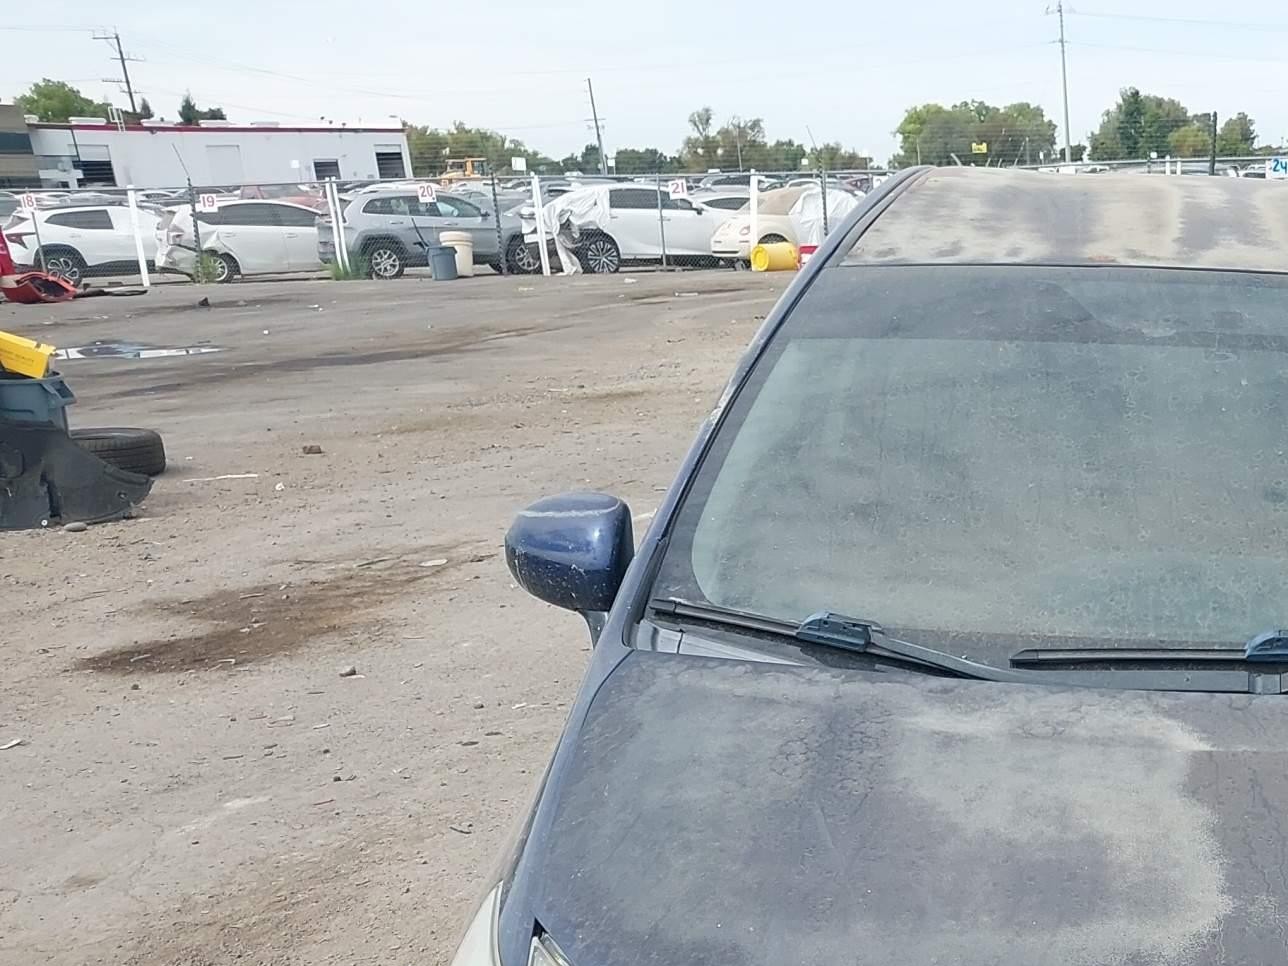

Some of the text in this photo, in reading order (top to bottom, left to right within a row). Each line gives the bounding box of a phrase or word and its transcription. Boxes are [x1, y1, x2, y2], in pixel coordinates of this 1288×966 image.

[1272, 157, 1288, 174] 24
[419, 185, 433, 198] 20
[671, 182, 685, 194] 21
[20, 195, 35, 209] 18
[201, 195, 215, 208] 19
